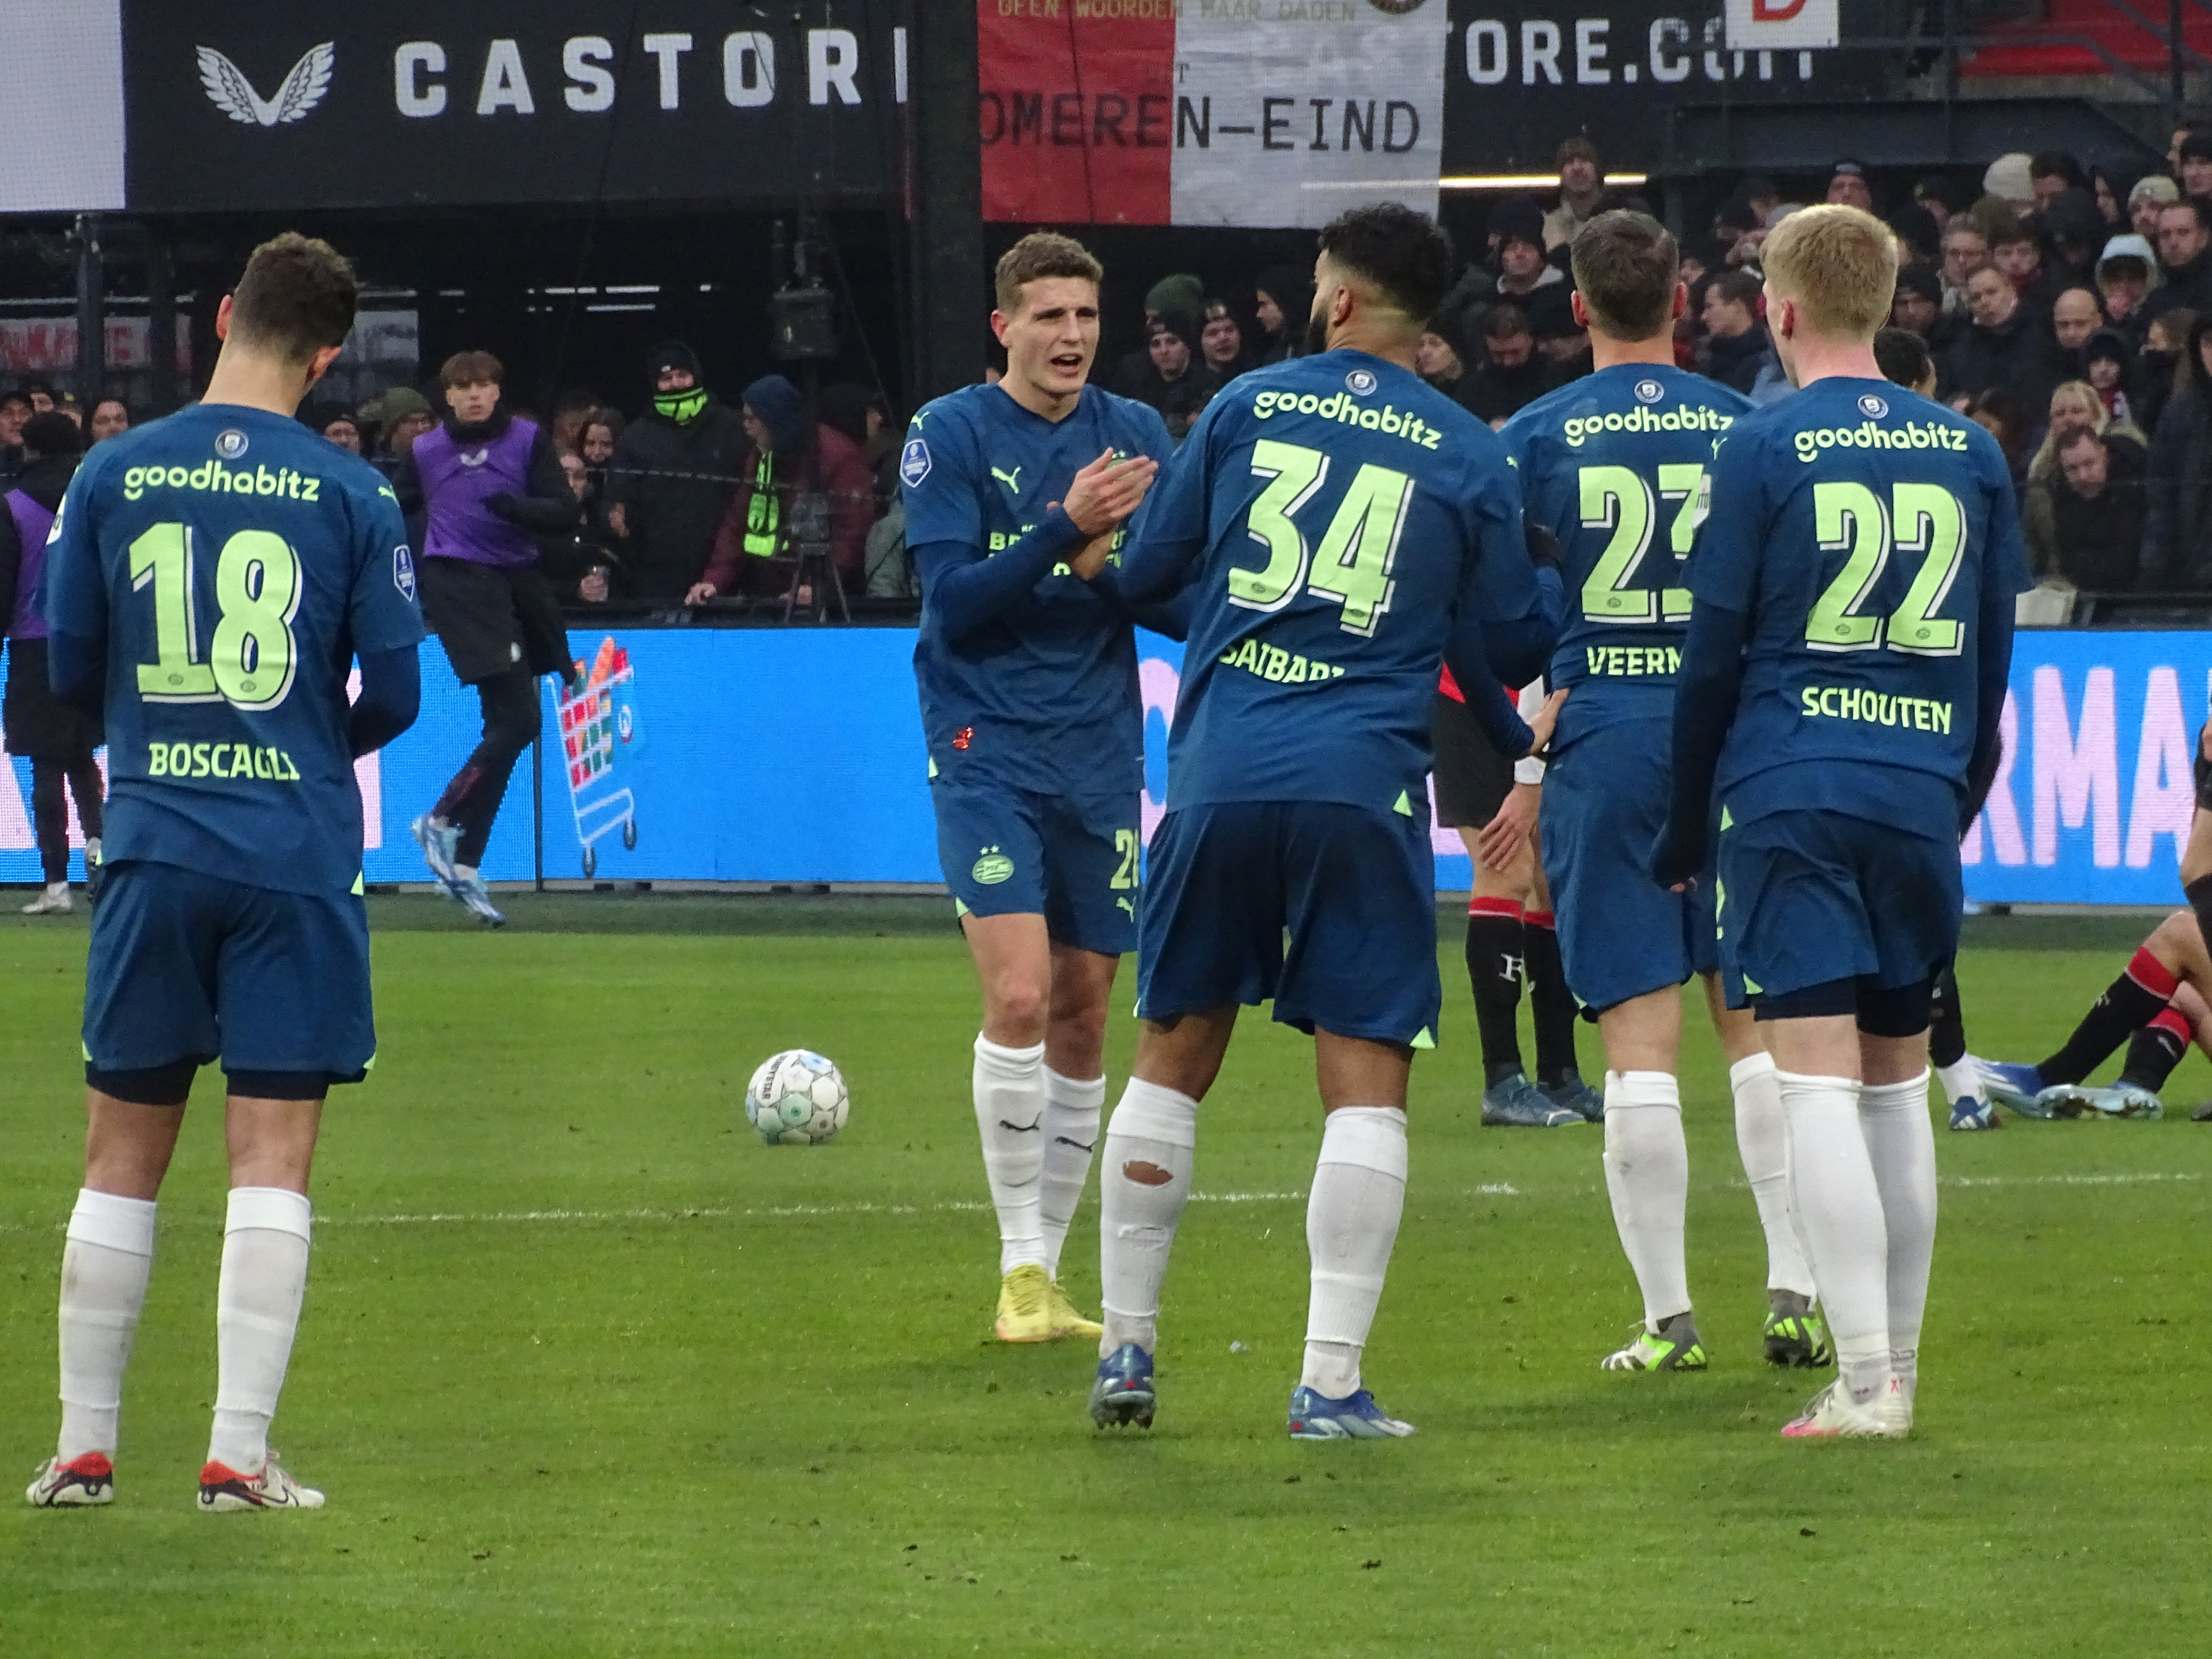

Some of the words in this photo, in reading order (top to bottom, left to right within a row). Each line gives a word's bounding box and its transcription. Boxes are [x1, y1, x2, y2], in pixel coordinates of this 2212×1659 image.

[395, 28, 908, 117] CASTOR
[979, 91, 1420, 153] OMEREN-EIND
[1253, 391, 1442, 450] goodhabitz
[1794, 422, 1968, 463] goodhabitz
[123, 460, 320, 501] goodhabitz
[1228, 439, 1416, 638] 34
[1805, 482, 1967, 656] 22
[128, 522, 302, 711] 18
[1801, 686, 1952, 734] SCHOUTEN
